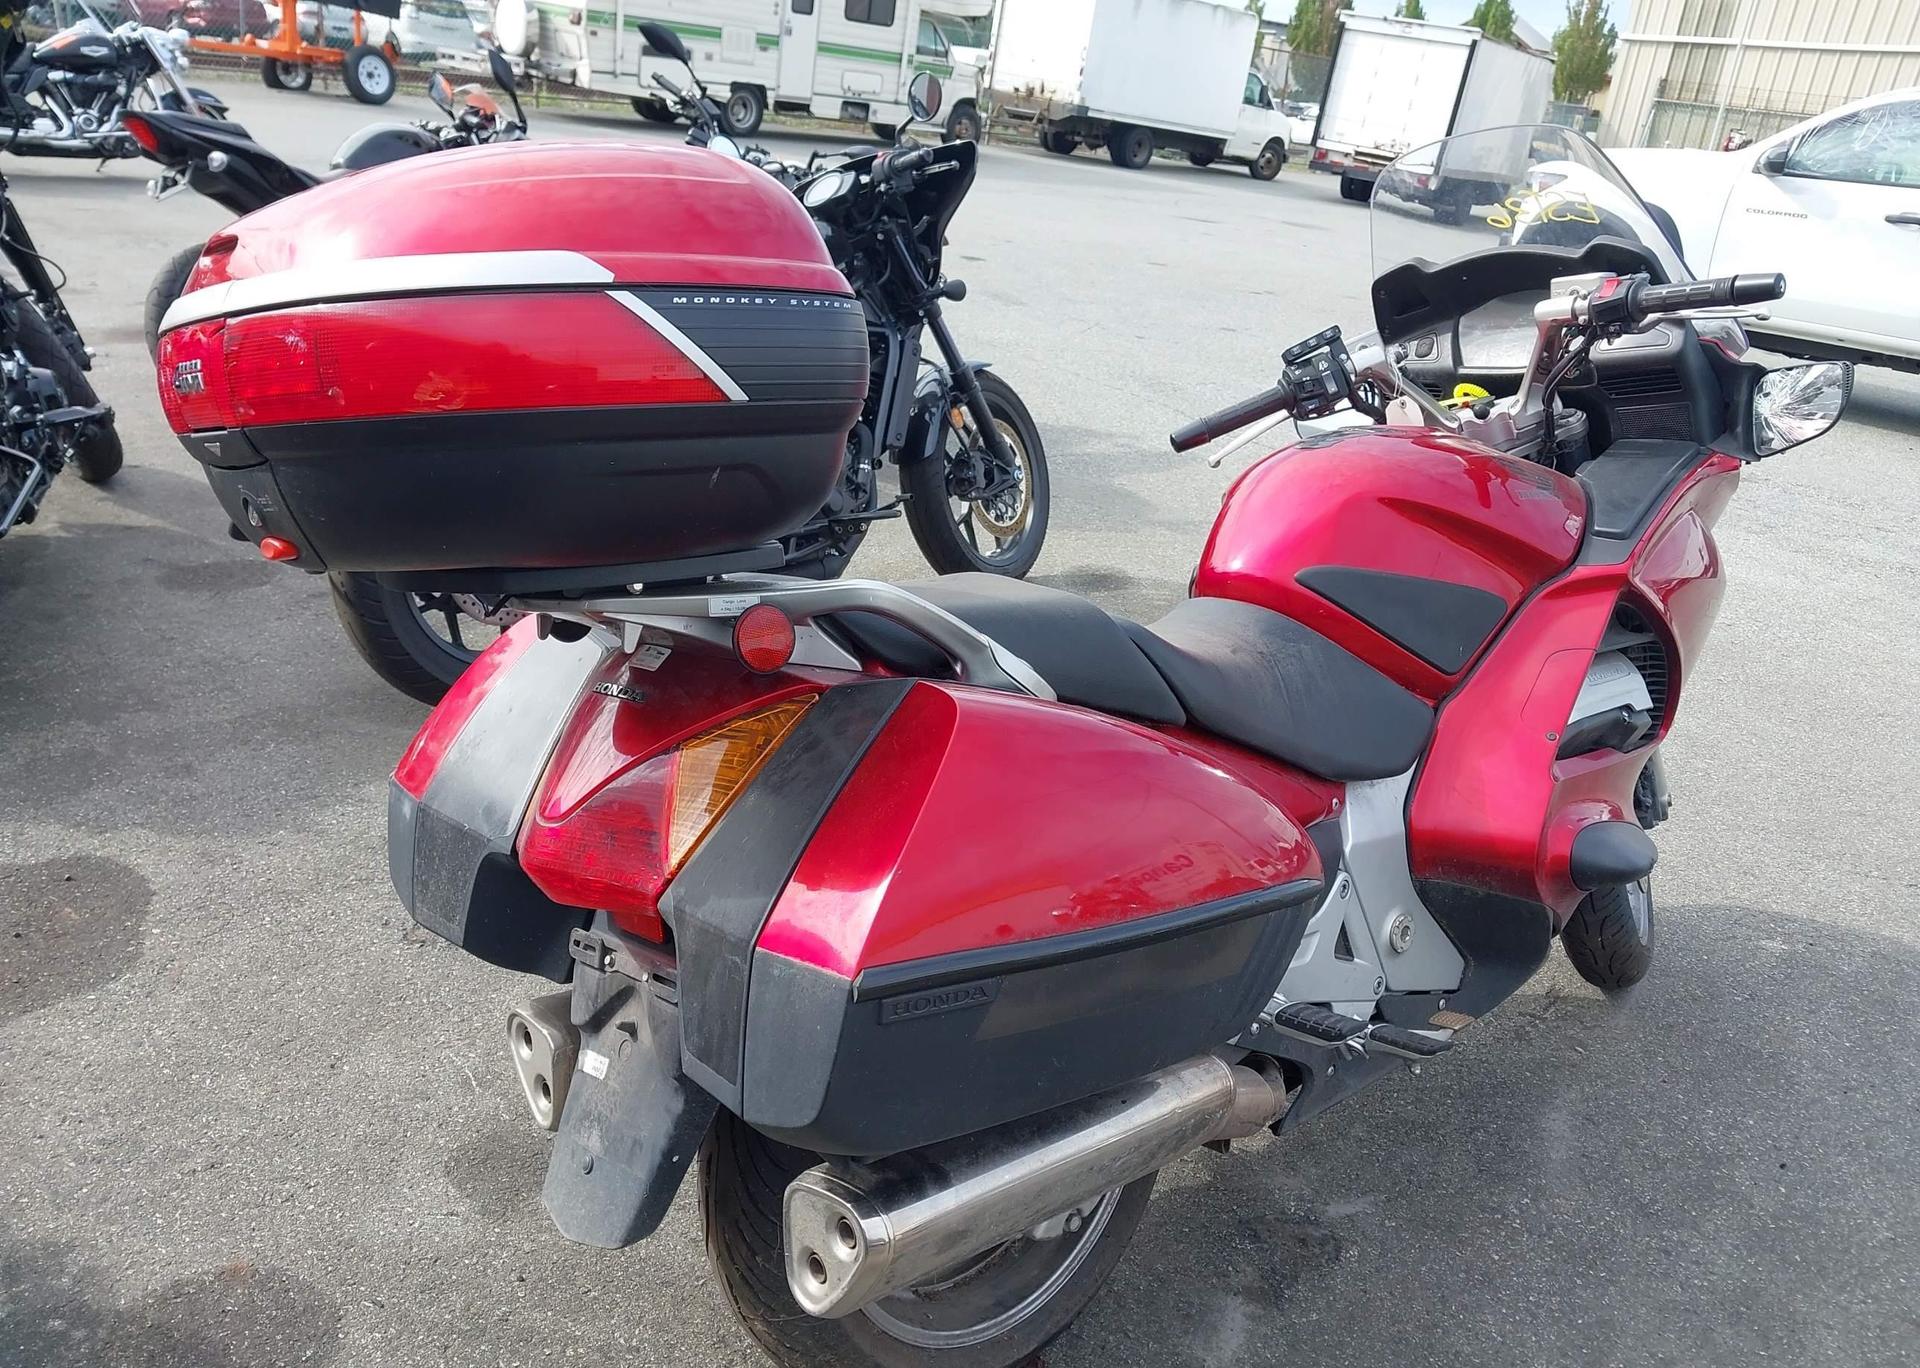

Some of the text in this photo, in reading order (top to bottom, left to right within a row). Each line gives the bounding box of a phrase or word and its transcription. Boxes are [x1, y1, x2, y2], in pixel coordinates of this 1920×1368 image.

[1745, 207, 1809, 220] COLORADO
[672, 296, 852, 309] MONOKEY SYSTEM
[593, 682, 648, 702] HONDA
[889, 986, 990, 1019] HONDA
